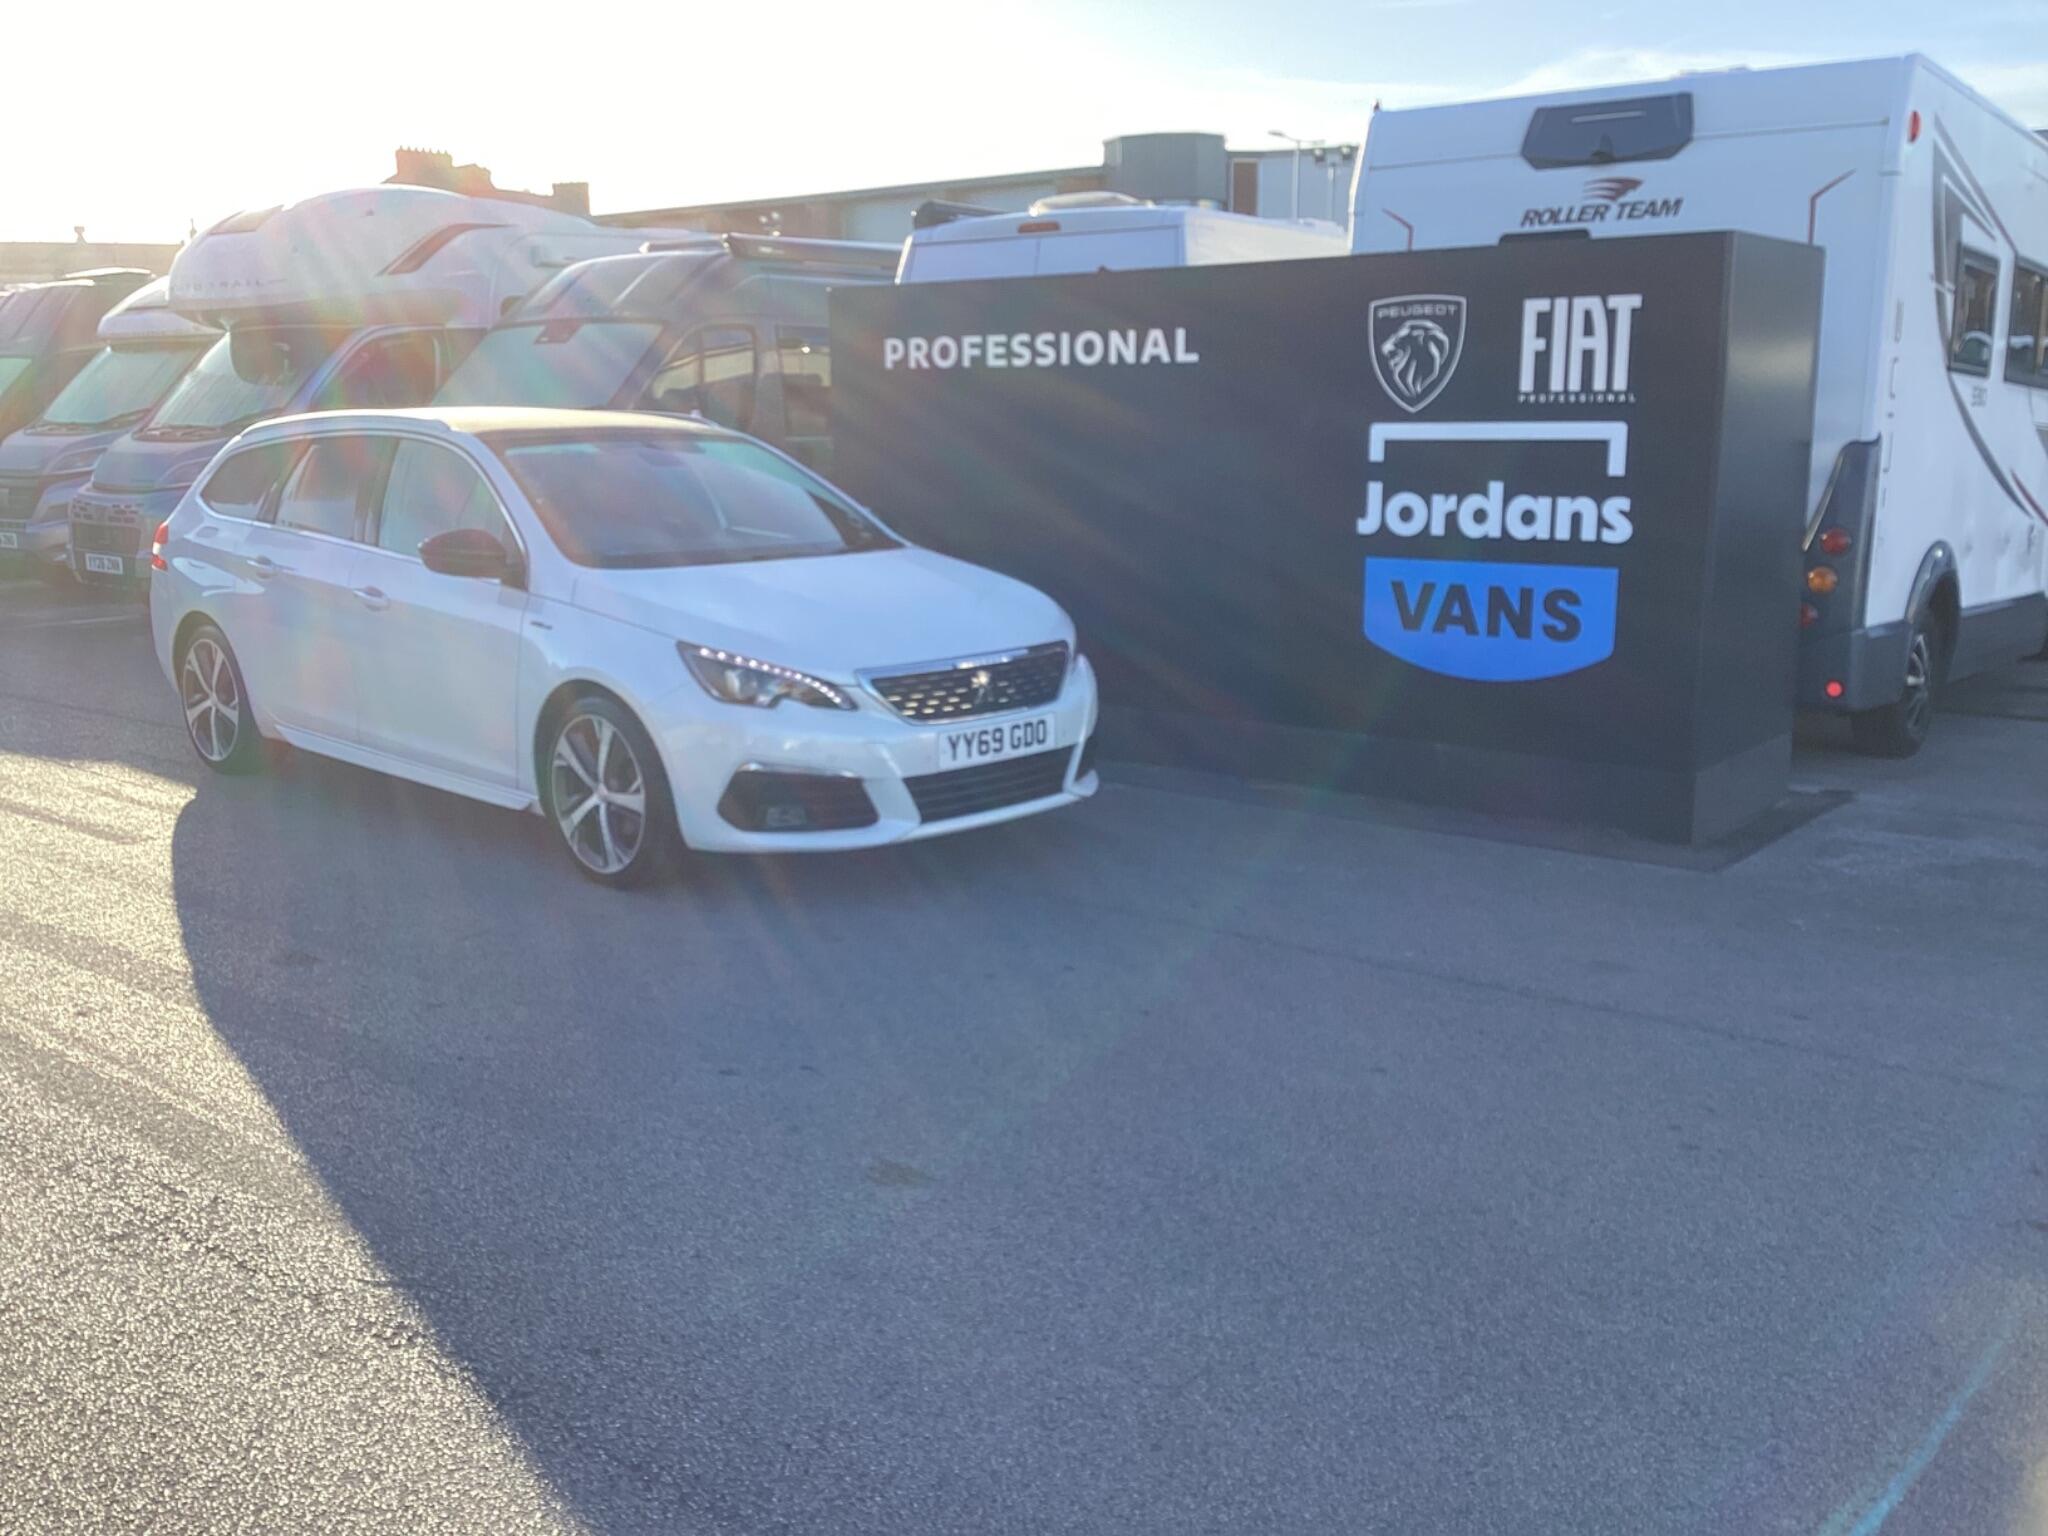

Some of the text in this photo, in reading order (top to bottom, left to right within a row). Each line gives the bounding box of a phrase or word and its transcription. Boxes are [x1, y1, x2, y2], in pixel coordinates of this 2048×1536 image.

[1520, 198, 1684, 228] ROLLER TEAM
[1376, 303, 1458, 318] PEUGEOT
[883, 327, 1199, 369] PROFESSIONAL
[1519, 294, 1642, 392] FIAT
[1517, 392, 1636, 403] PROFESSIONAL
[1356, 480, 1634, 544] Jordans
[1391, 580, 1583, 643] VANS
[947, 719, 1047, 761] YY69 GDO
